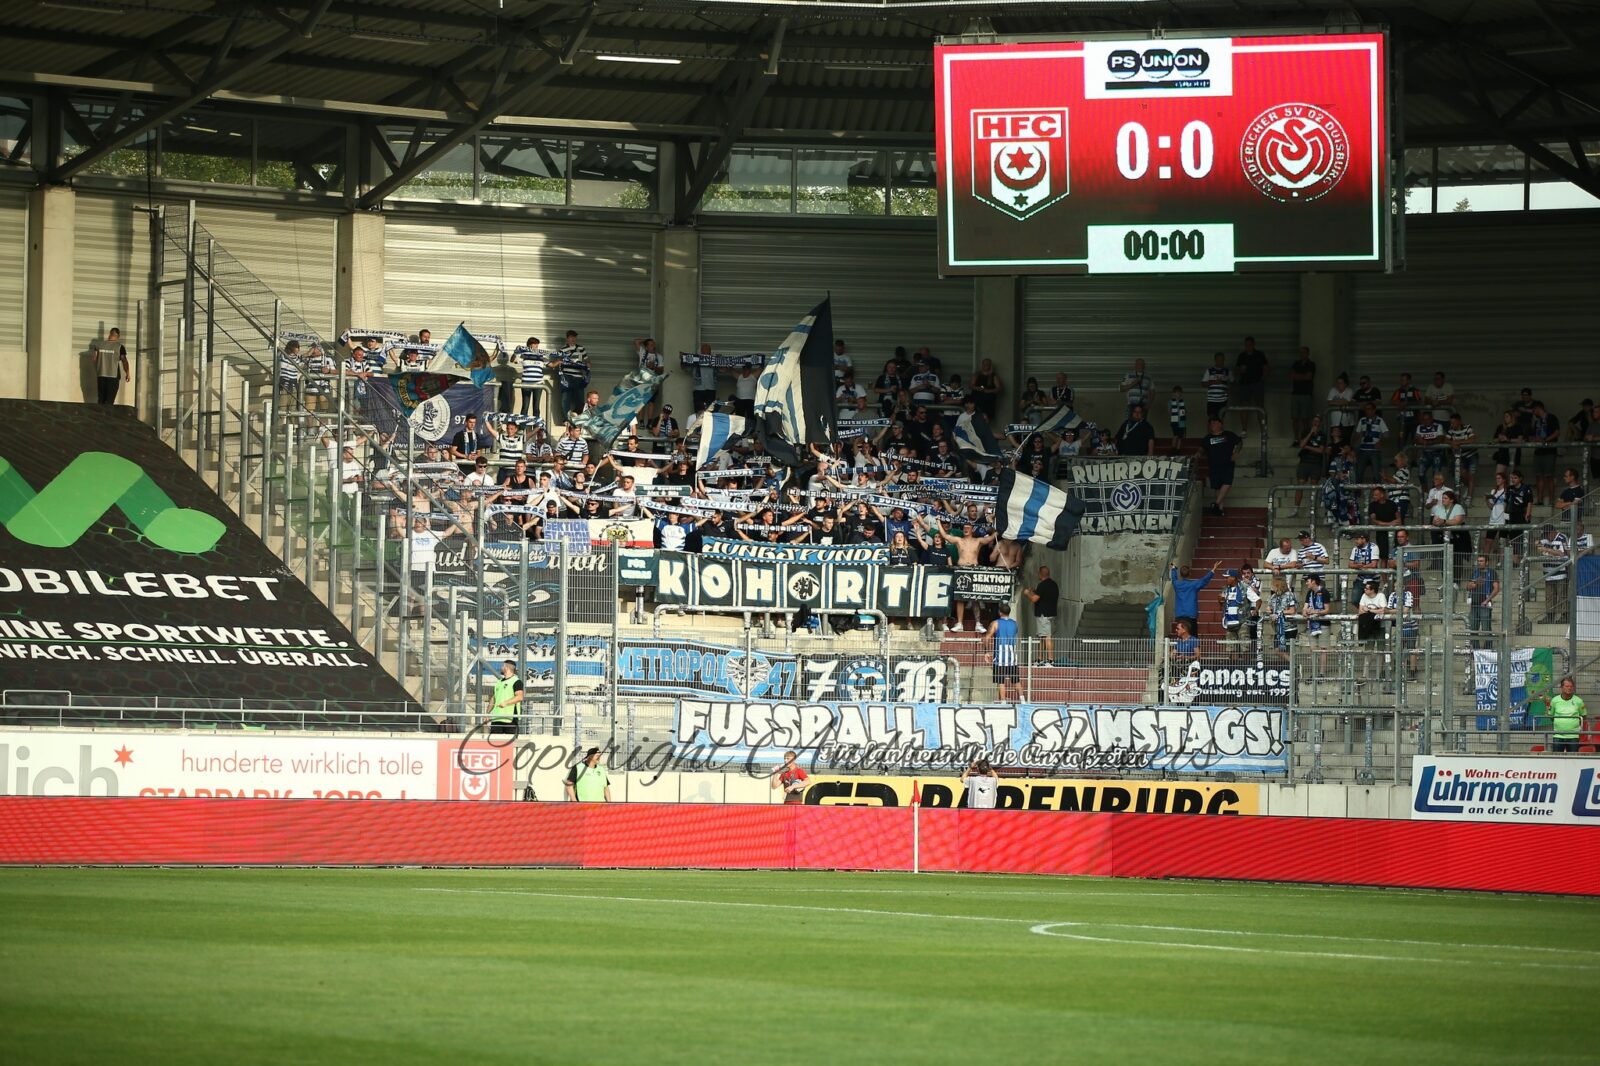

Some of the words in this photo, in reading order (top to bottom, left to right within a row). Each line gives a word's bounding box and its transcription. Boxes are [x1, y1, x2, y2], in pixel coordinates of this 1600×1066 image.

[1111, 56, 1136, 68] PS
[1141, 54, 1203, 67] UNION
[982, 116, 1057, 138] HFC
[1116, 120, 1214, 180] 0:0
[1245, 111, 1279, 192] MEIDERICHER
[1284, 106, 1303, 117] SV
[1307, 110, 1325, 123] 02
[1324, 120, 1346, 186] DUISBURG
[1124, 229, 1205, 261] 00:00
[1072, 460, 1182, 484] RUHRPOTT
[1080, 513, 1173, 533] KANAKEN
[545, 542, 592, 553] VEBOT
[702, 541, 890, 562] JUNGSPUNDE
[972, 574, 1011, 584] SEKTION
[73, 622, 349, 648] SPORTWETTE.
[102, 646, 237, 666] SCHNELL.
[237, 648, 368, 667] ÜBERALL.
[617, 647, 730, 688] METROPOL
[767, 662, 796, 697] 47
[678, 701, 925, 750] FUSSBALL
[938, 707, 1017, 750] IST
[1031, 706, 1285, 756] SAMSTAGS!
[182, 749, 283, 774] hunderte
[291, 752, 371, 775] wirklich
[379, 753, 424, 775] tolle
[457, 755, 494, 768] HFC
[1465, 769, 1557, 780] Wohn-Centrum
[919, 783, 1240, 816] PPENBURG
[1414, 765, 1559, 814] Lührmann
[1468, 806, 1484, 814] an
[1487, 804, 1509, 815] der
[1512, 806, 1554, 817] Saline
